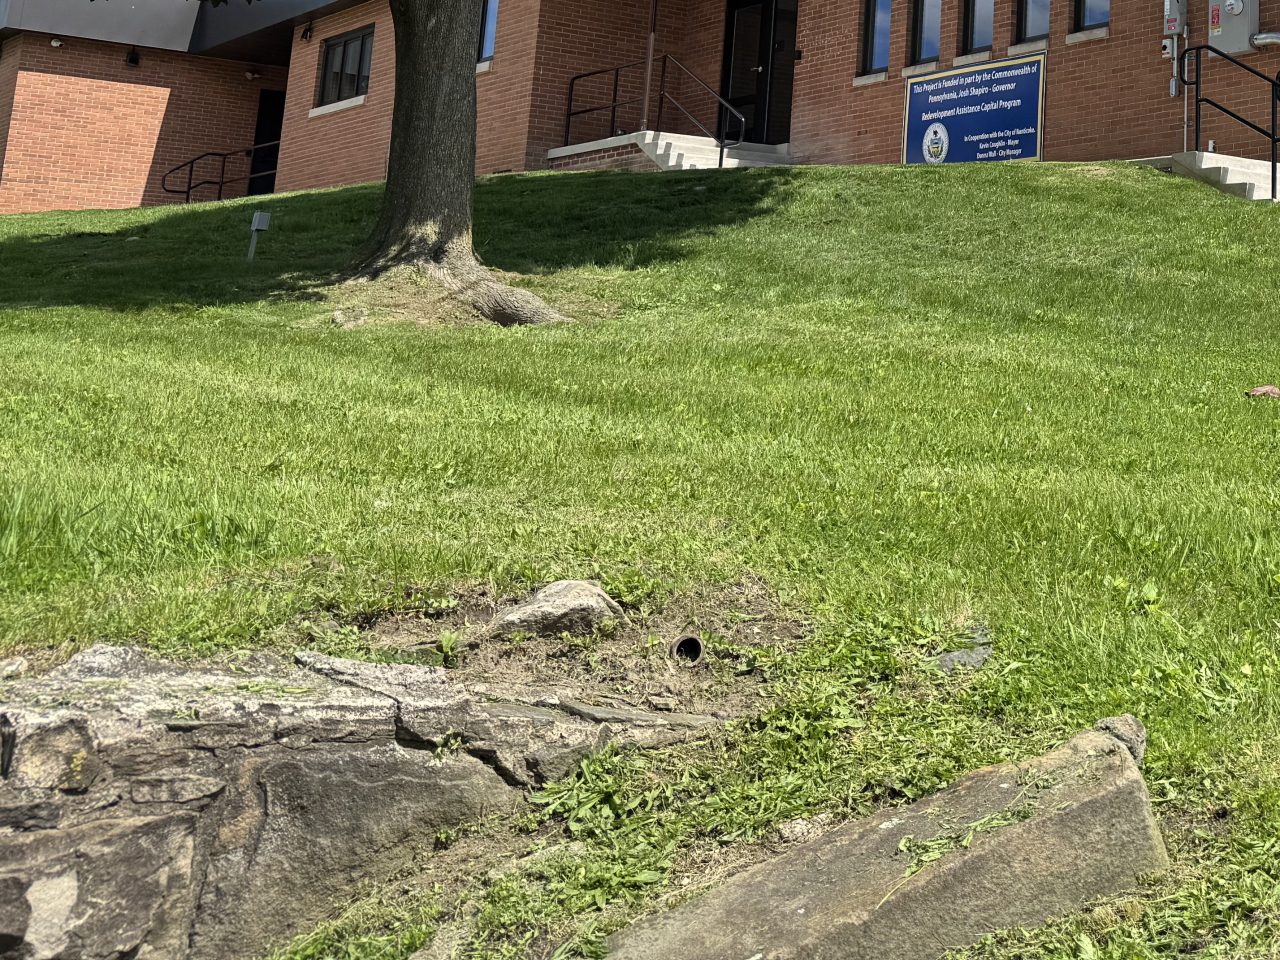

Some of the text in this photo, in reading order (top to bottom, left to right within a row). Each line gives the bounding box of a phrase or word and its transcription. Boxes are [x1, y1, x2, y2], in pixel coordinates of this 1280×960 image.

[913, 85, 923, 94] This
[923, 82, 938, 93] Project
[942, 76, 960, 88] Funded
[959, 76, 964, 85] in
[964, 74, 975, 86] part
[975, 73, 982, 83] by
[982, 72, 991, 81] the
[991, 64, 1031, 80] Commonwealth
[1031, 63, 1038, 73] of
[928, 91, 958, 104] Pennsylvania,
[958, 88, 969, 98] Josh
[969, 85, 989, 97] Shapiro
[992, 82, 1017, 93] Governor
[921, 99, 1022, 121] Redevelopment Assistance Capital Program
[968, 133, 989, 142] Cooperation
[989, 130, 998, 139] with
[1004, 129, 1012, 138] City
[998, 149, 1006, 158] City
